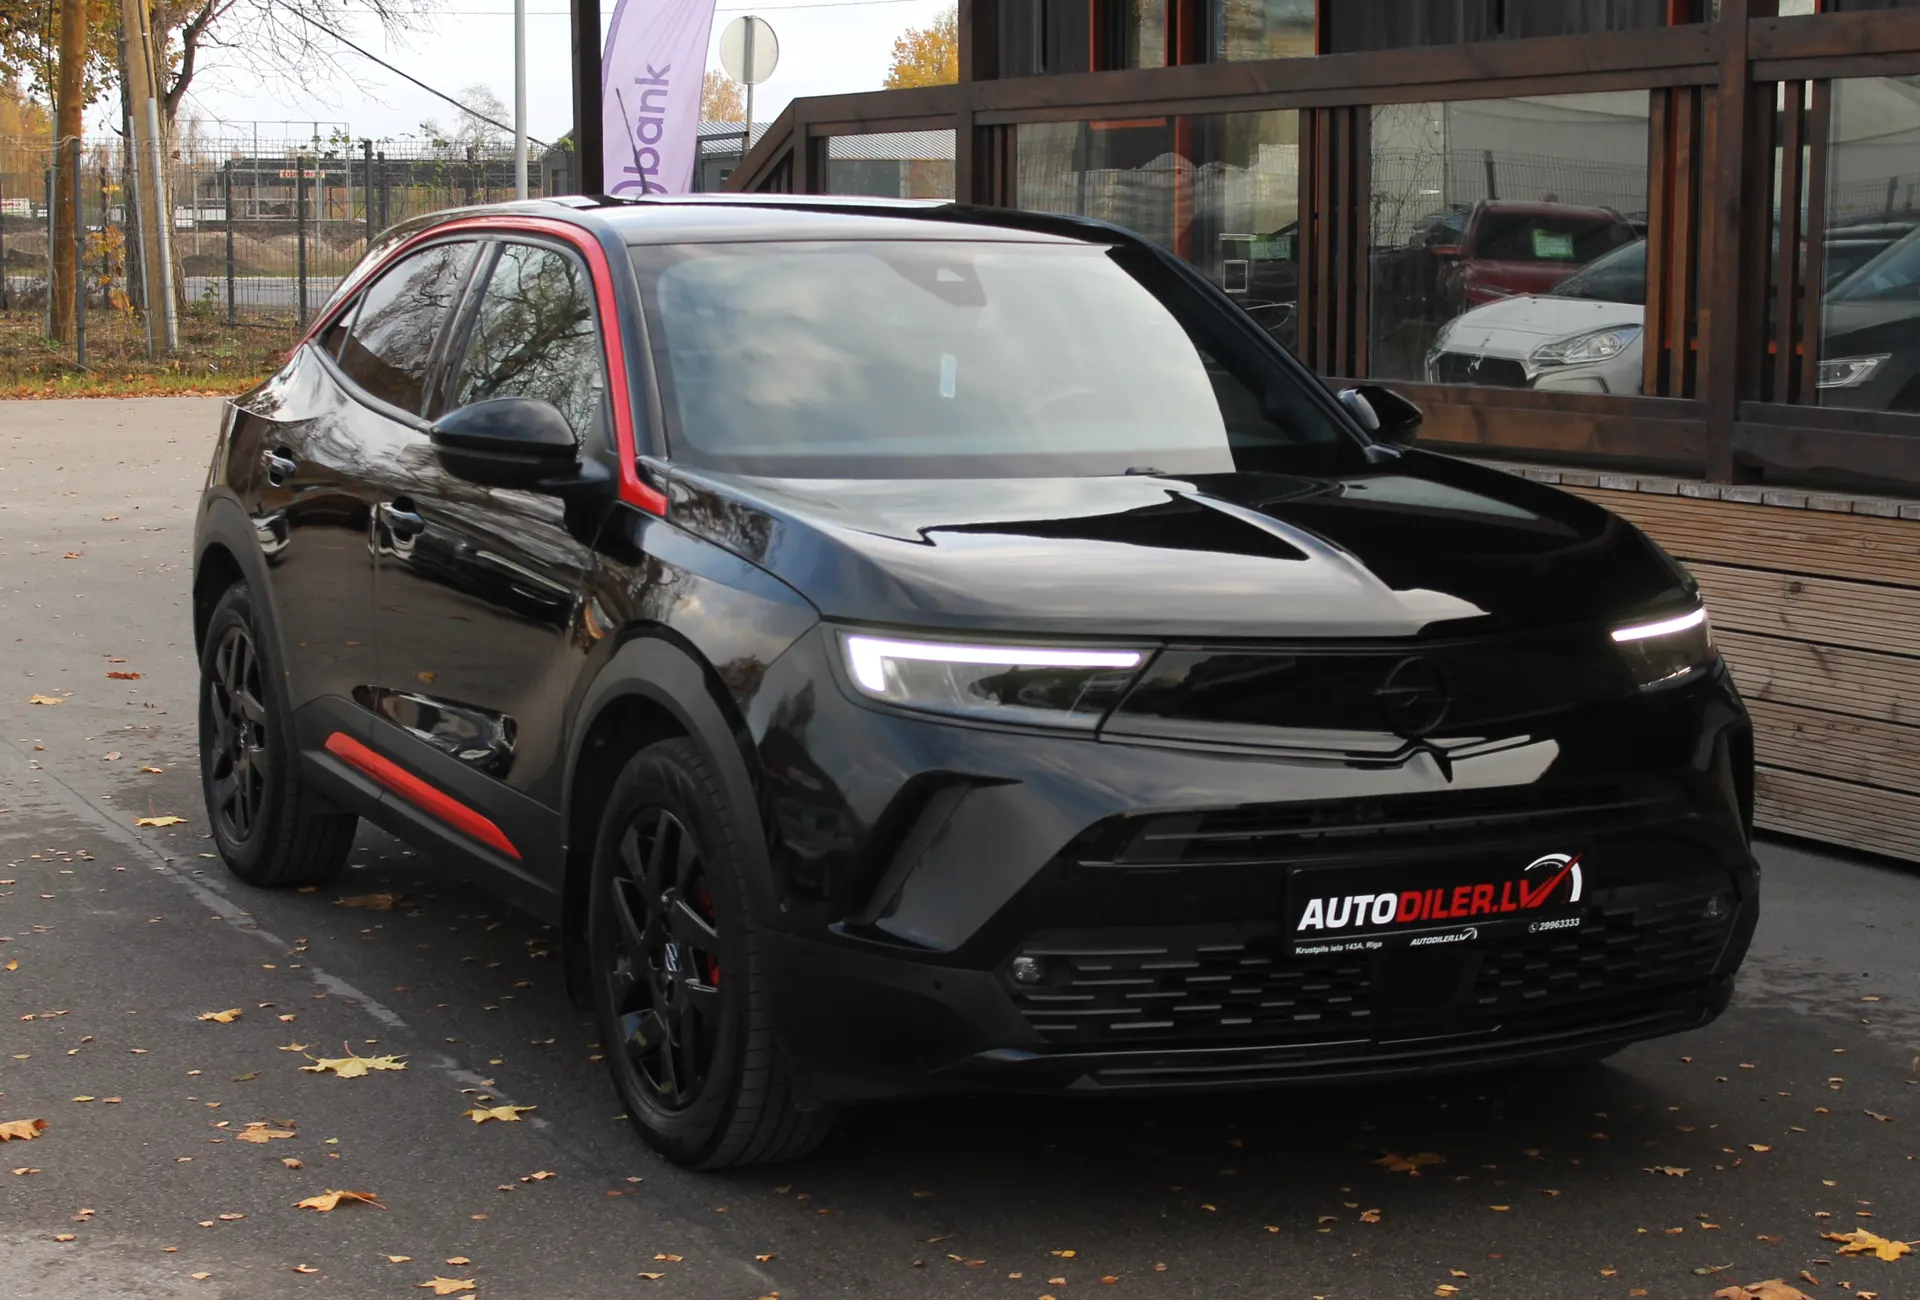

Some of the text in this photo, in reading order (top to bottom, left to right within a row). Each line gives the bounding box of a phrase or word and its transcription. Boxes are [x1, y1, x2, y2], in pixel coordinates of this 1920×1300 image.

[1297, 875, 1562, 931] AUTODILER.LV
[1538, 917, 1581, 931] 29963333
[1295, 944, 1329, 955] Krustpils
